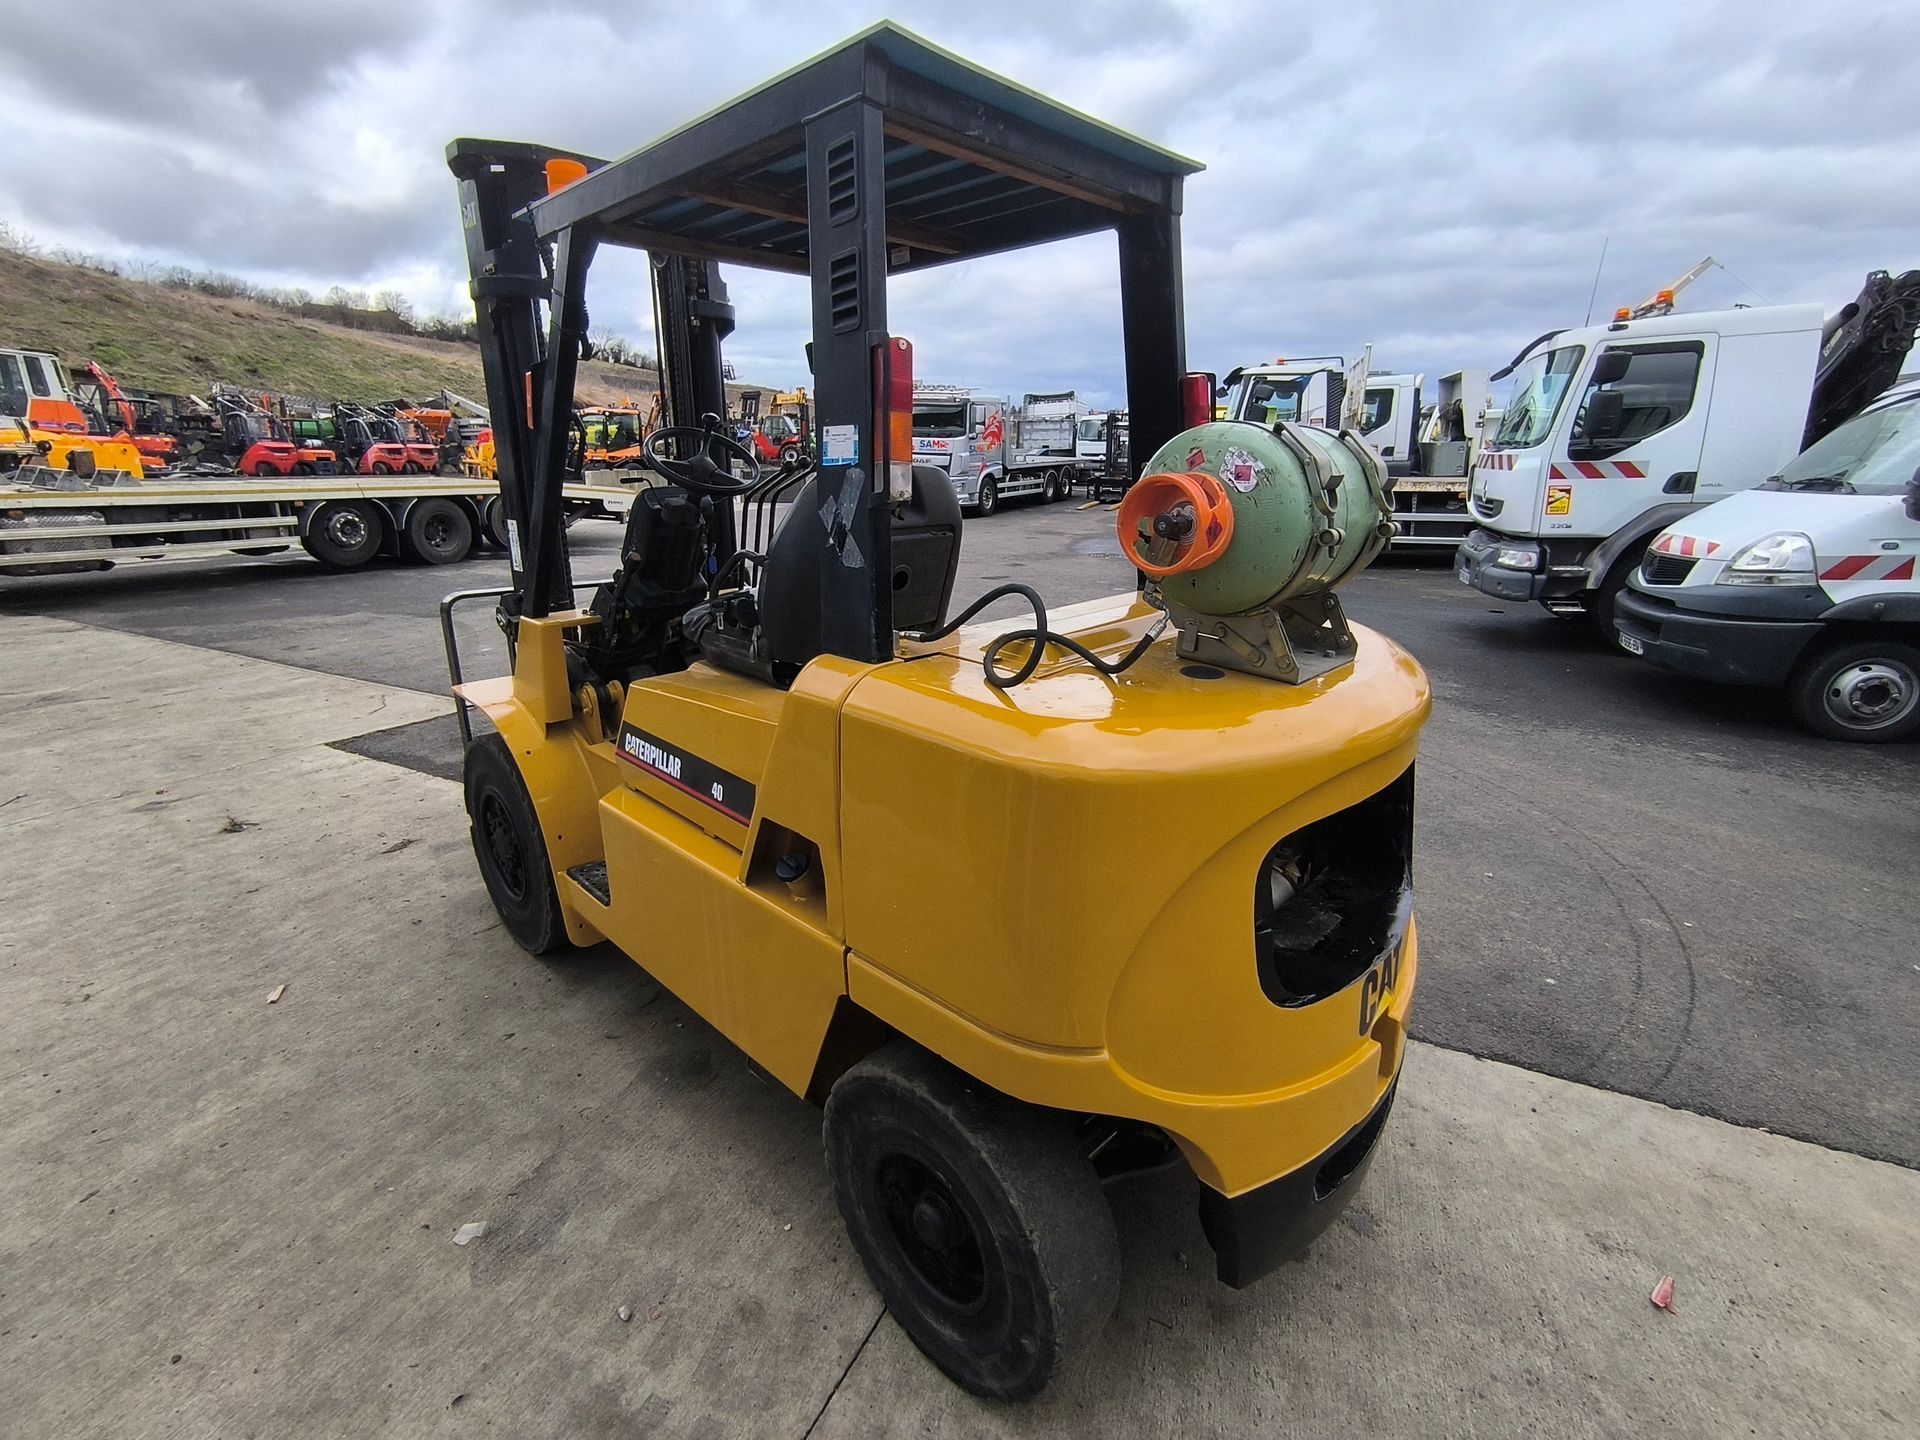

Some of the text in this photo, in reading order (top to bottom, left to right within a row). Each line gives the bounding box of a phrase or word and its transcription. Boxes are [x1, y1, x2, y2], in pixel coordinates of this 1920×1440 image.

[625, 732, 724, 802] CATERPILLAR 40
[1359, 936, 1402, 1035] CAT
